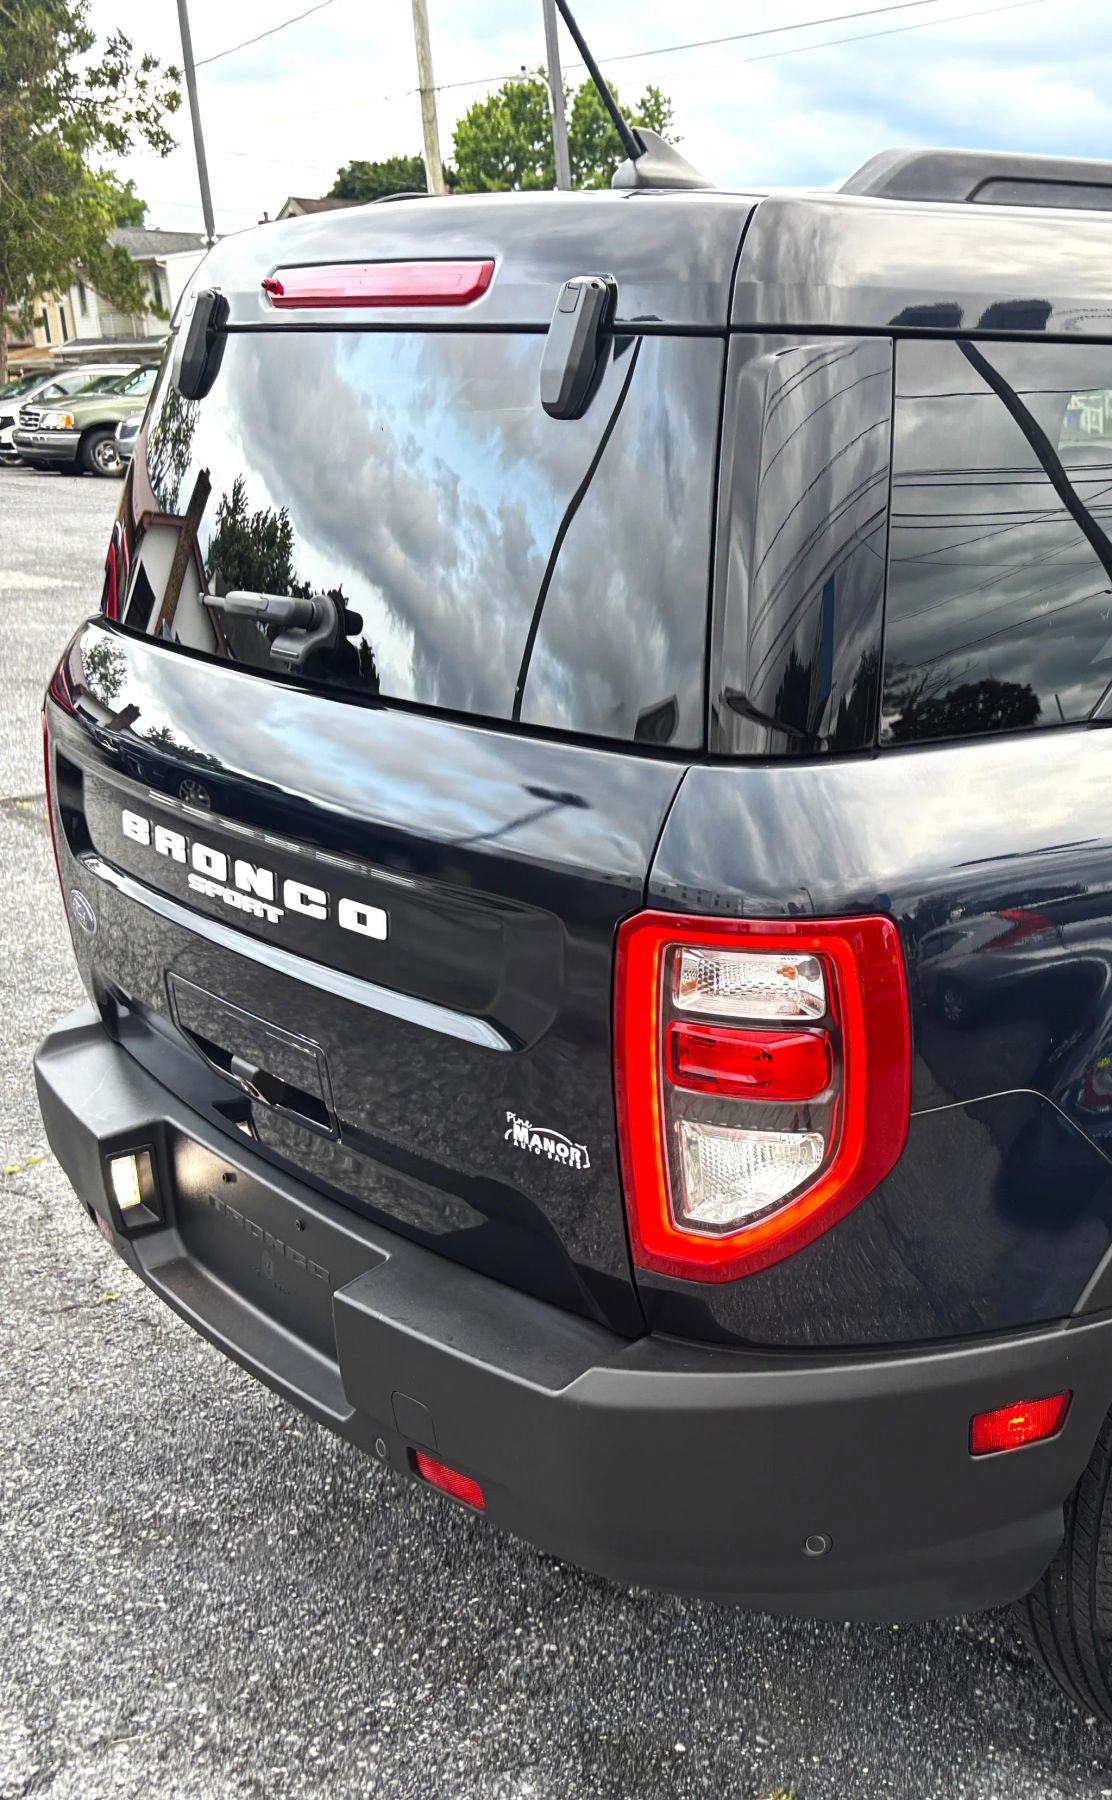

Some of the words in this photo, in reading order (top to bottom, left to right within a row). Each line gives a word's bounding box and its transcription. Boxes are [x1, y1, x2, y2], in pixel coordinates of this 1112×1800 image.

[122, 809, 389, 941] BRONCO
[188, 873, 285, 924] SPORT
[506, 1111, 532, 1128] Pine
[513, 1123, 581, 1161] MANOR
[513, 1139, 541, 1155] AUTO
